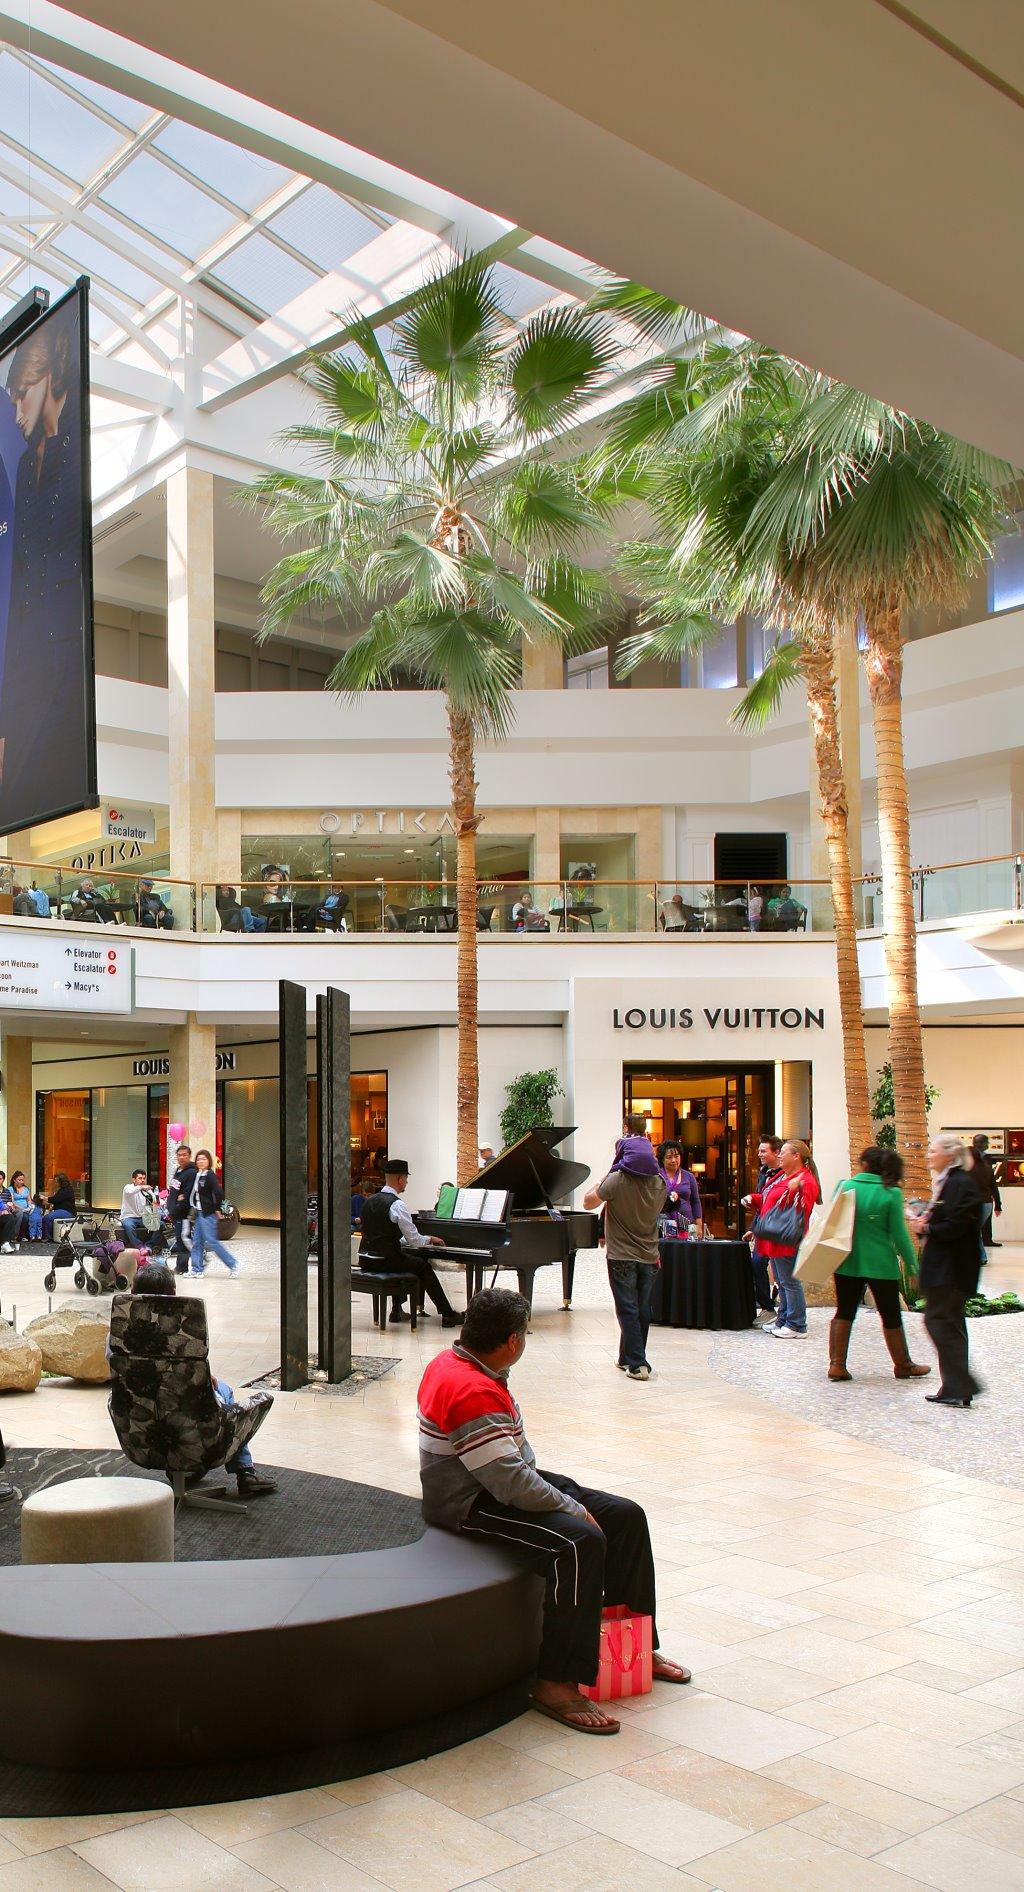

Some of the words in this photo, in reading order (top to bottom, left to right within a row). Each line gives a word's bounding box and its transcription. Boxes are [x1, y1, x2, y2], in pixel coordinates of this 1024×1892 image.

[320, 812, 454, 834] OPTIKA
[108, 824, 146, 839] Escalator
[72, 841, 143, 874] OPTIKA
[74, 948, 101, 959] Elevator
[11, 960, 39, 969] Weitzman
[74, 962, 106, 974] Escalator
[10, 986, 38, 994] Paradise
[613, 1008, 693, 1029] LOUIS
[703, 1008, 824, 1030] VUITTON
[133, 1059, 169, 1076] LOUIS
